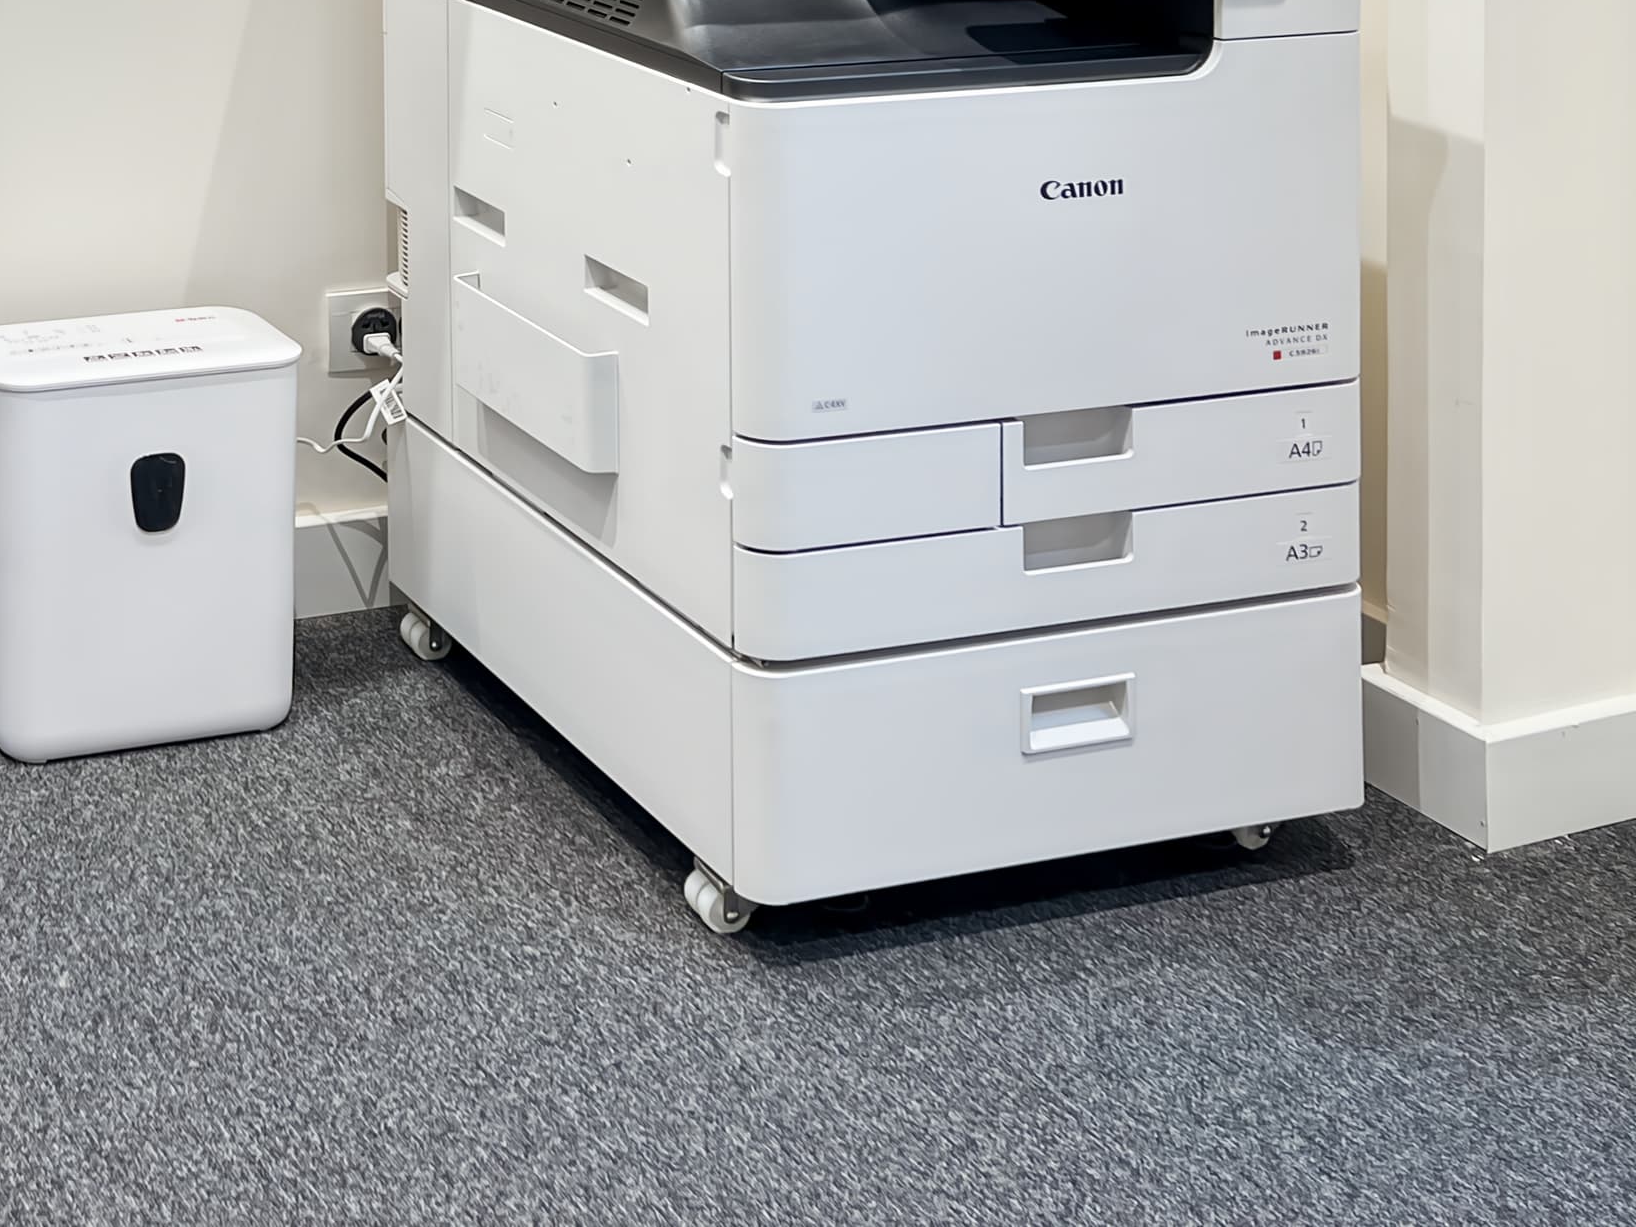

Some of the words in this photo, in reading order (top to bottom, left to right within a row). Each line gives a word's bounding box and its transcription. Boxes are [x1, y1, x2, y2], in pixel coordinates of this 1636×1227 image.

[1039, 178, 1124, 200] Canon
[1245, 322, 1329, 338] imageRUNNER
[1265, 335, 1313, 347] ADVANCE
[1315, 333, 1329, 342] DX
[1288, 441, 1312, 459] A4
[1300, 520, 1308, 532] 2
[1285, 544, 1309, 561] A3
